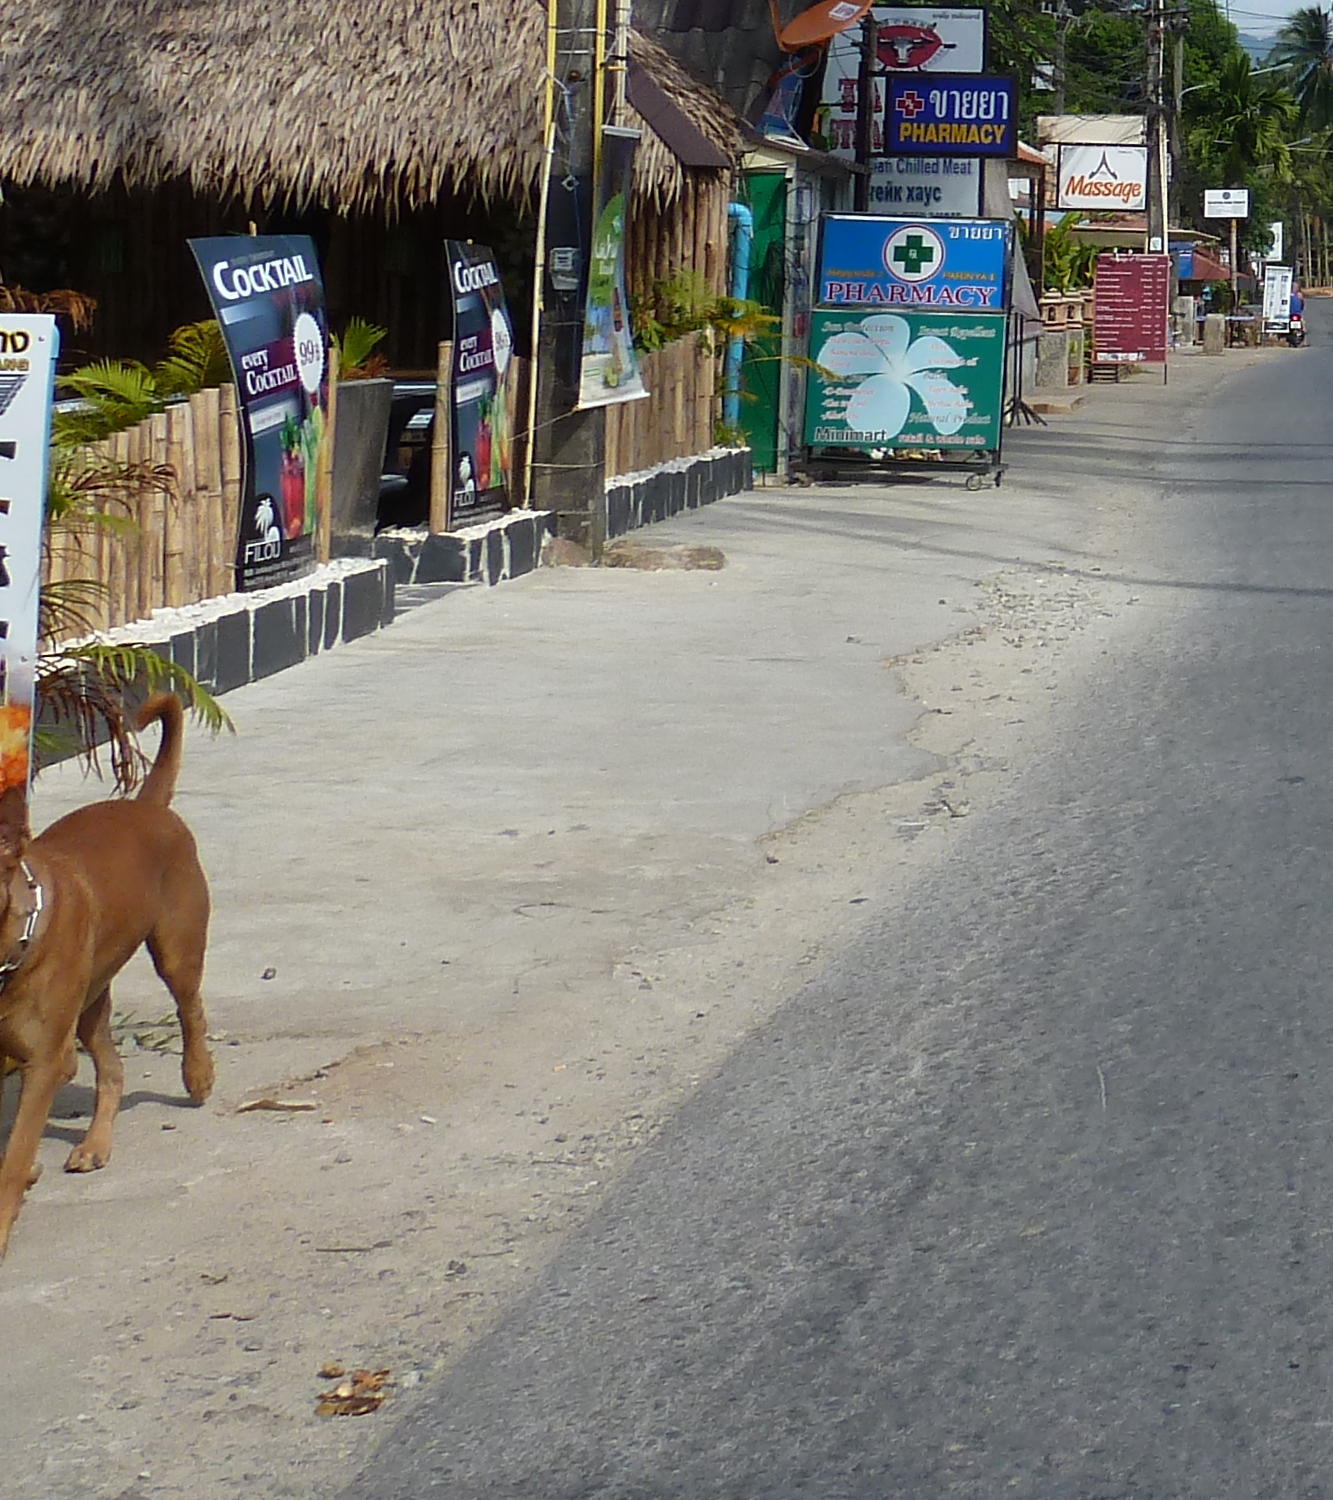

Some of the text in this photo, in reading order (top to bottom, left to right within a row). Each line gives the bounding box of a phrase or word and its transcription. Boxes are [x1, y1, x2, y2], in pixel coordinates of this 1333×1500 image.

[929, 90, 1008, 119] ขายยา
[900, 122, 1006, 144] PHARMACY
[896, 158, 939, 174] Chilled
[942, 158, 972, 174] Meat
[906, 186, 942, 206] хаус
[1065, 175, 1142, 204] Massage
[948, 225, 1003, 240] ขายยา
[213, 255, 313, 300] COCKTAIL
[454, 261, 498, 293] COCKTAIL
[825, 281, 997, 306] PHARMACY
[241, 349, 268, 371] every
[246, 364, 297, 395] COCKTAIL
[814, 426, 887, 442] Minimart
[245, 540, 281, 565] FILOU
